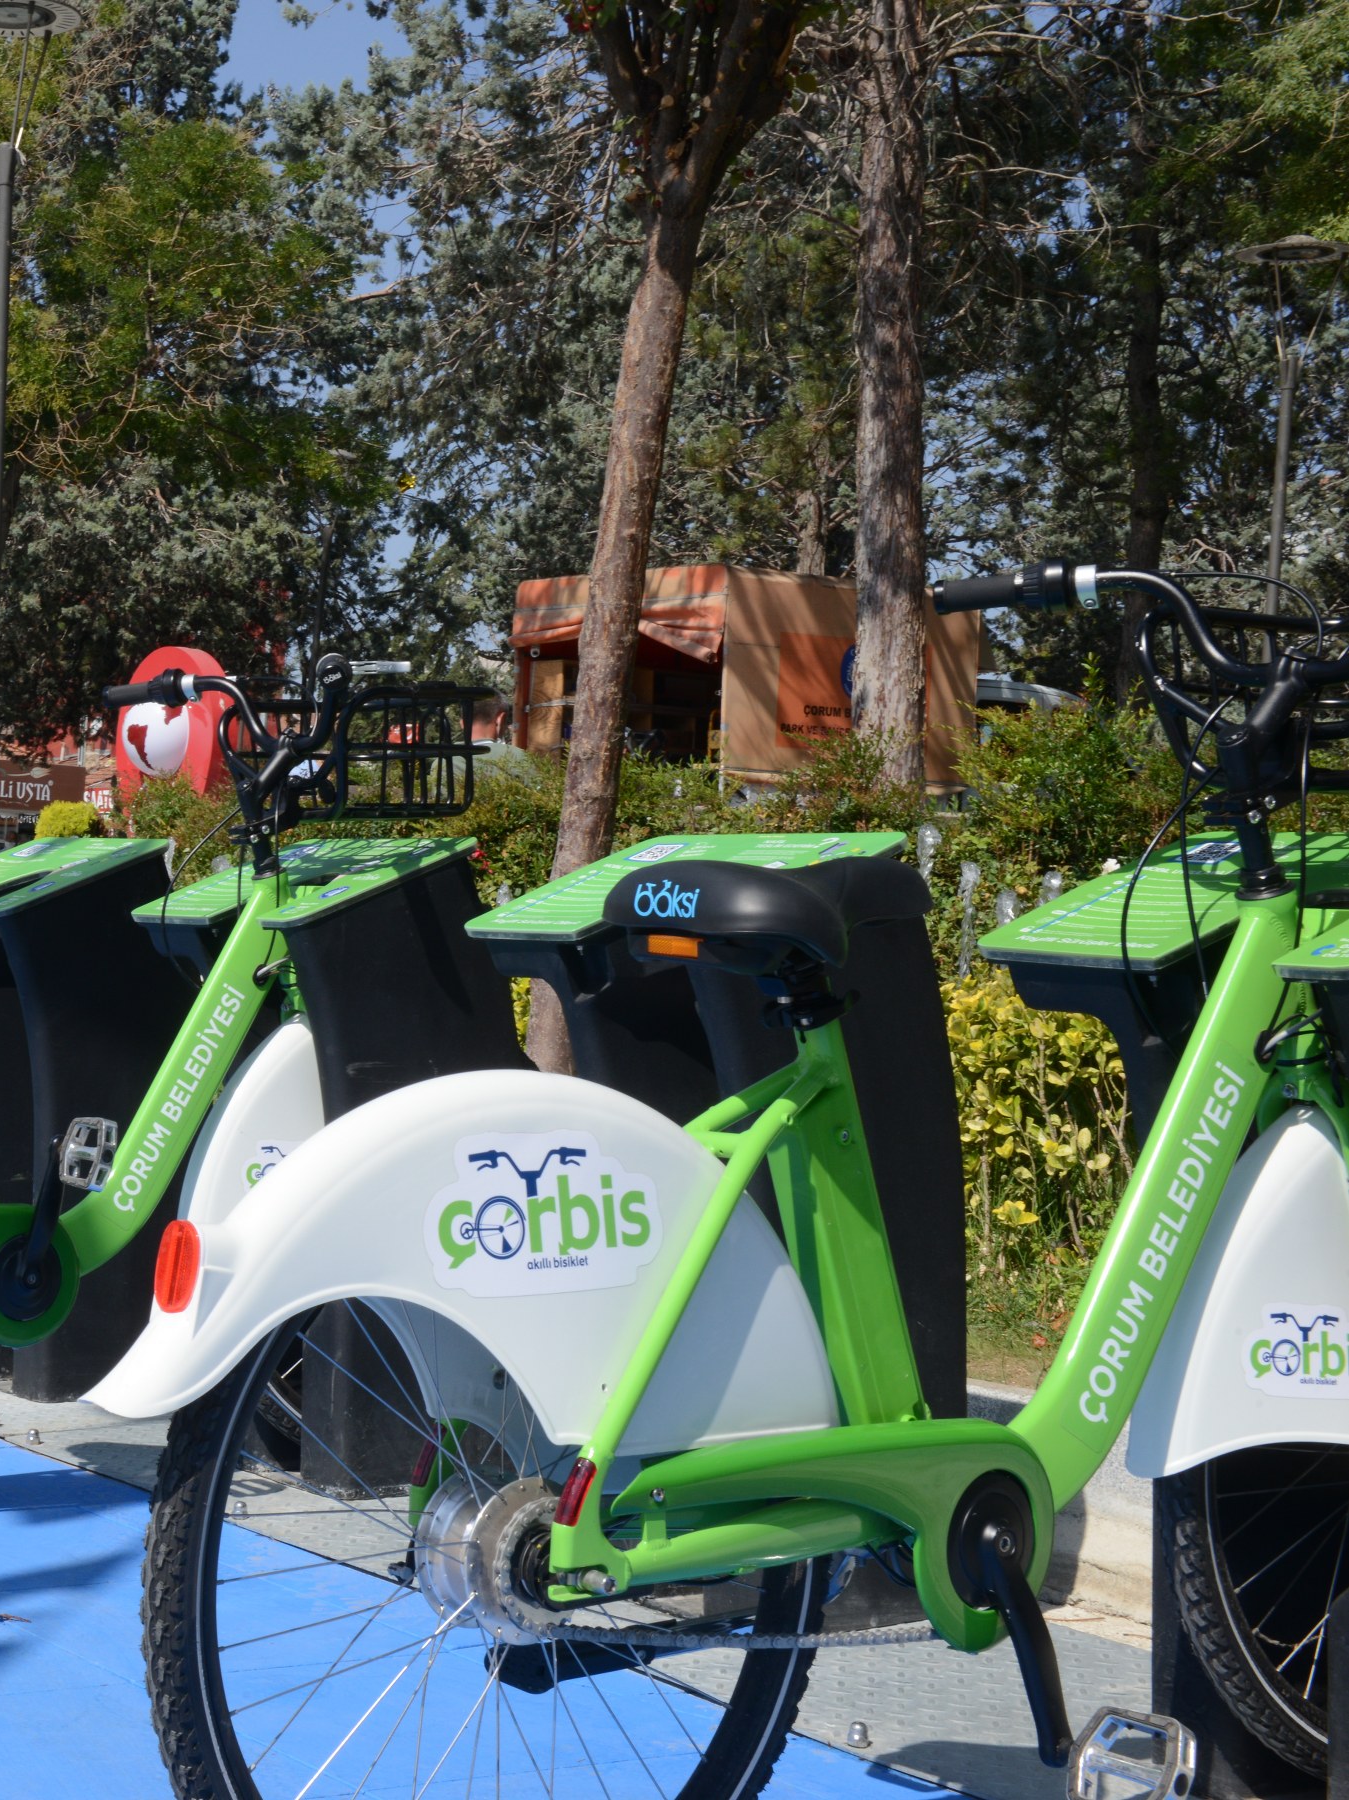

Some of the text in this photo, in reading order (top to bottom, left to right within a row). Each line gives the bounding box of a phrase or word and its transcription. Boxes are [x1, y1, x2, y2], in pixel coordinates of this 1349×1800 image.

[804, 705, 841, 717] ÇORUM
[16, 781, 51, 803] USTA
[113, 1120, 172, 1213] ÇORUM
[160, 982, 246, 1123] BELEDİYESİ
[438, 1174, 651, 1270] çorbis
[1078, 1060, 1246, 1424] ÇORUM BELEDİYESİ
[527, 1255, 589, 1271] akıllı bisiklet
